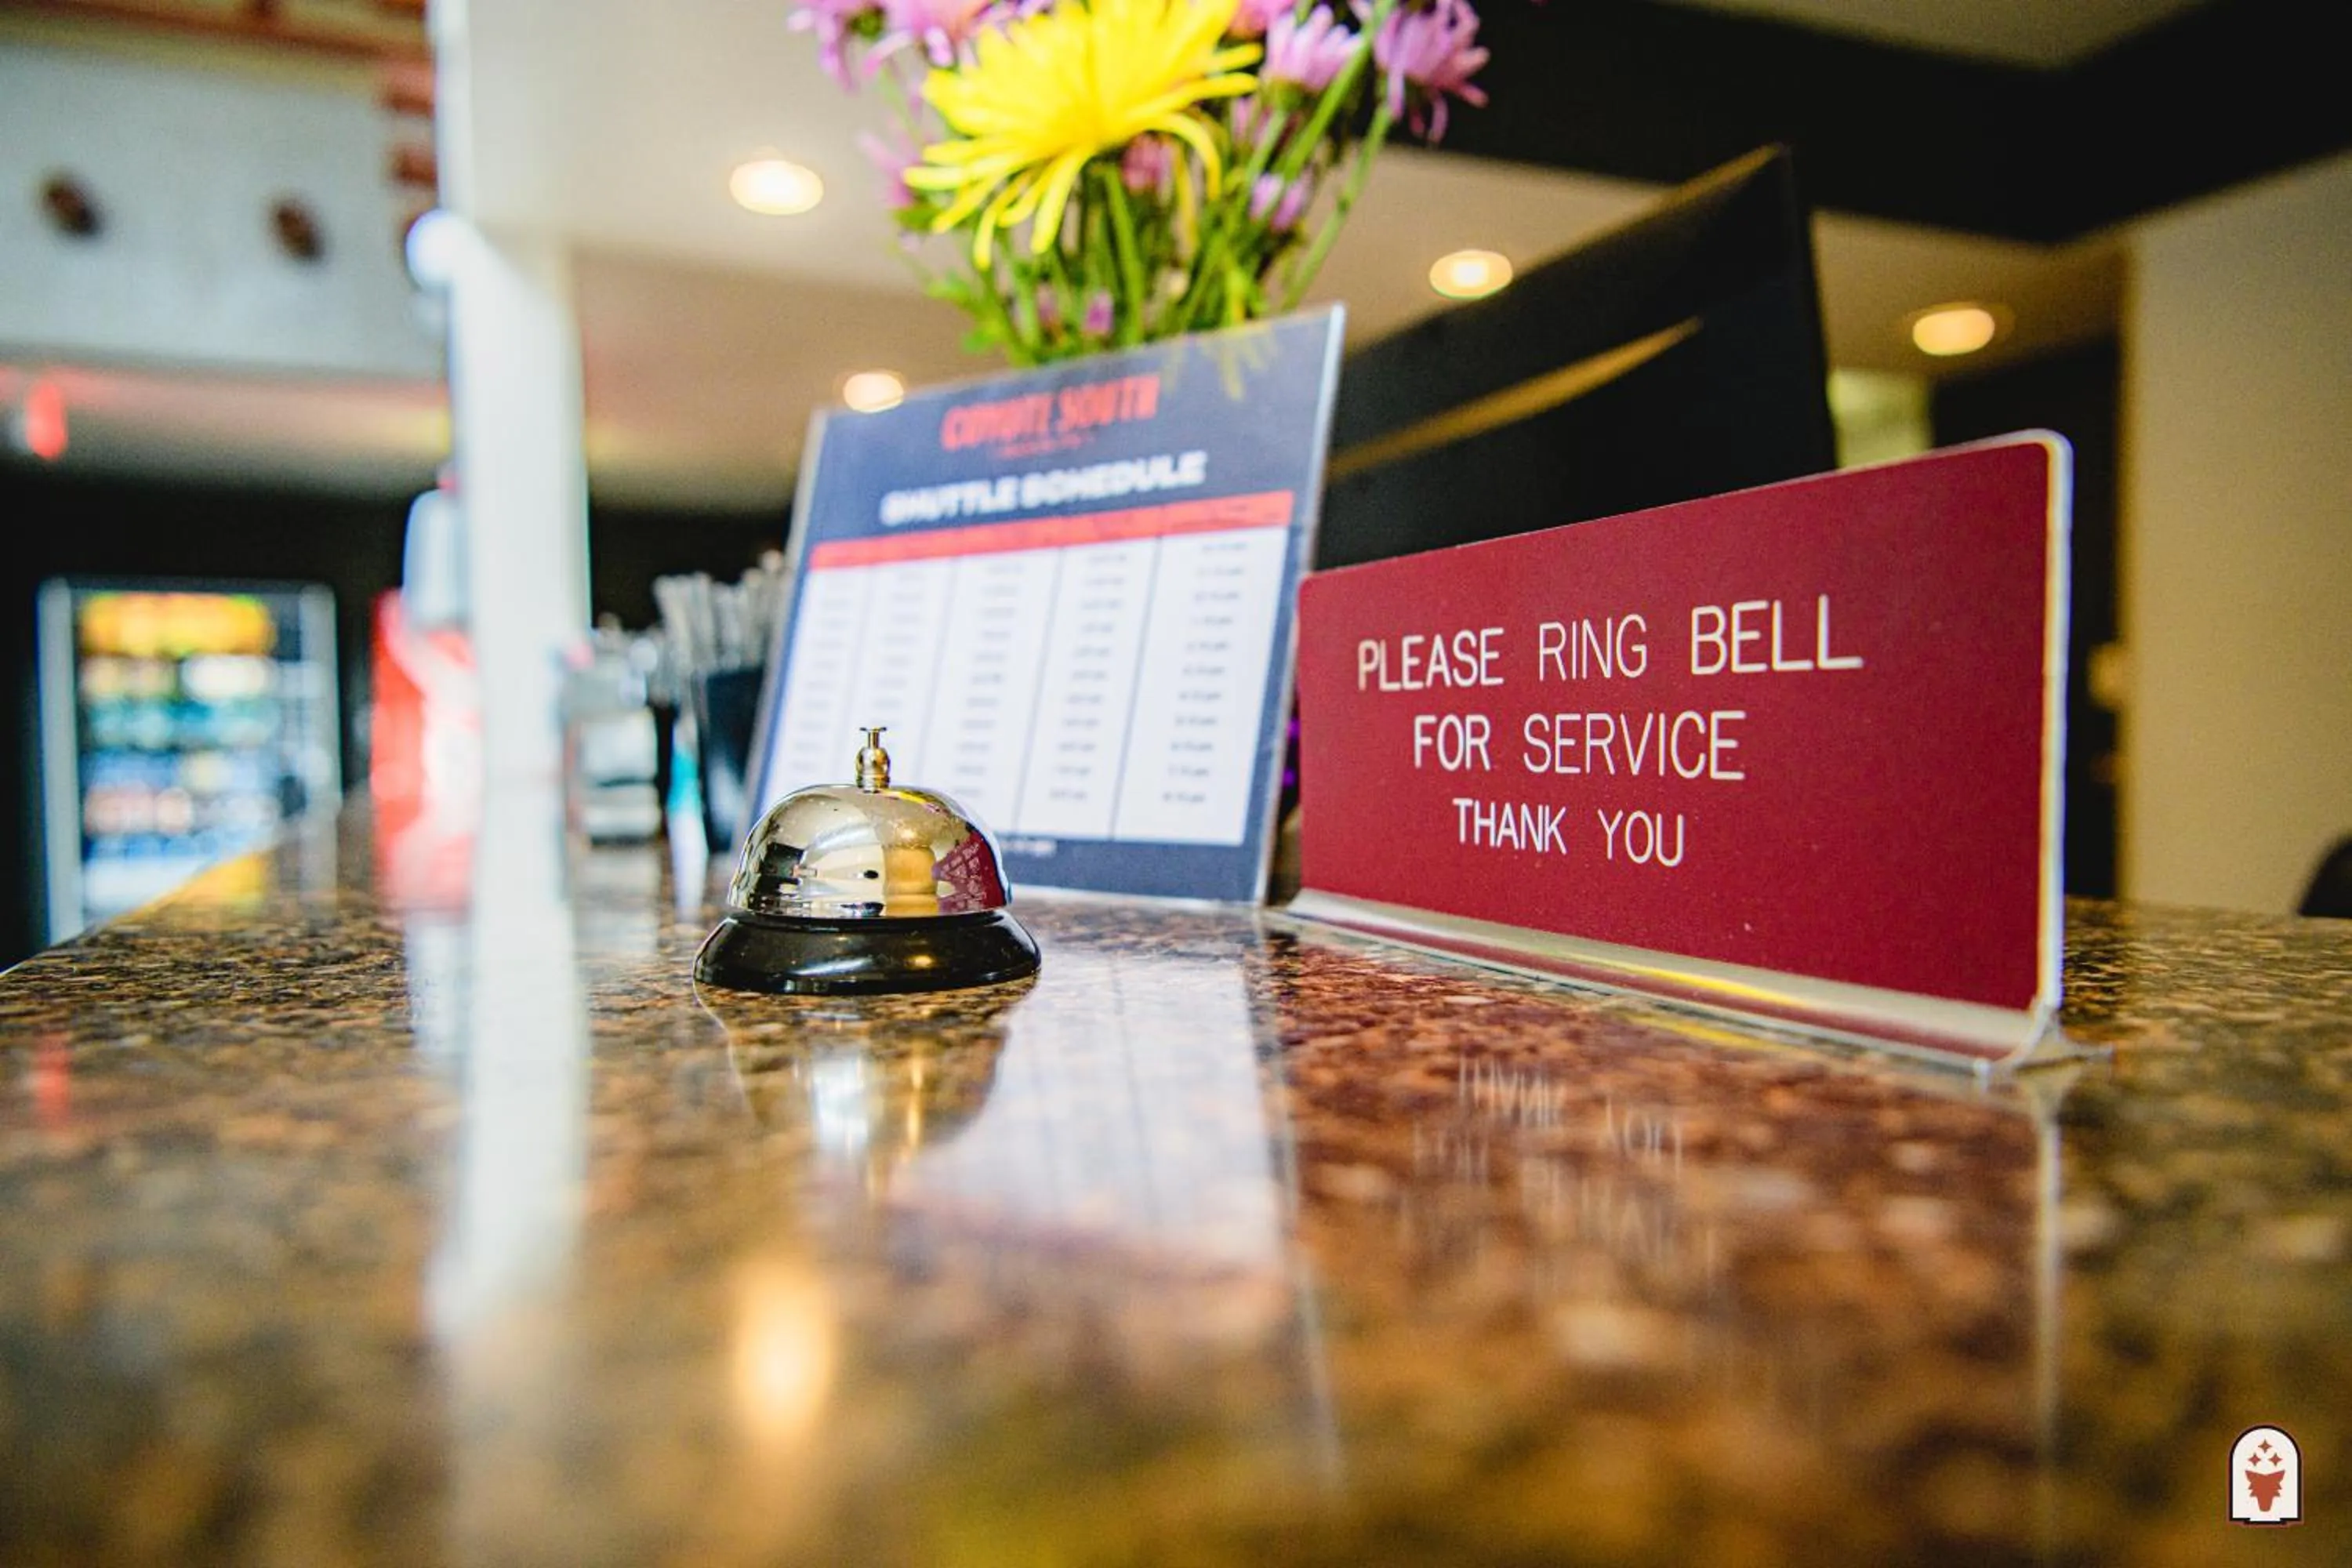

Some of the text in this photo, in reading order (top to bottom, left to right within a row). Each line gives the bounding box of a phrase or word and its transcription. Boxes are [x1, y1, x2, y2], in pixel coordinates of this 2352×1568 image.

[880, 450, 1208, 526] SHUTTLE SCHEDULE
[1357, 594, 1864, 691] PLEASE RING BELL
[1413, 710, 1747, 781] FOR SERVICE
[1451, 797, 1684, 867] THANK YOU
